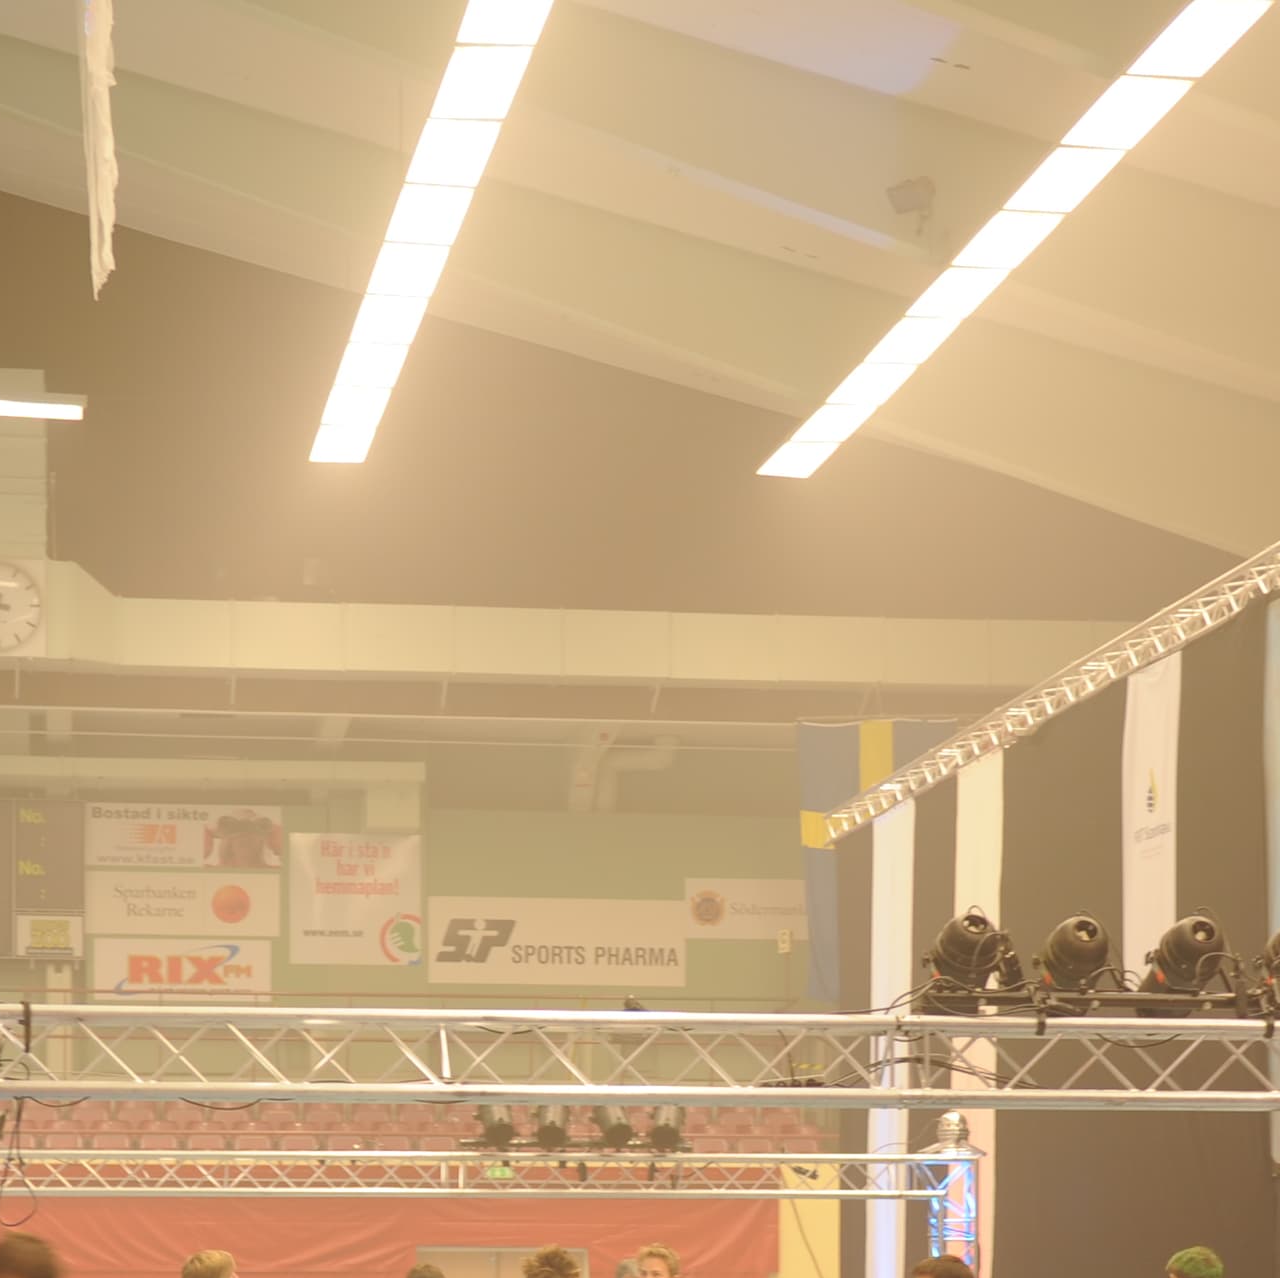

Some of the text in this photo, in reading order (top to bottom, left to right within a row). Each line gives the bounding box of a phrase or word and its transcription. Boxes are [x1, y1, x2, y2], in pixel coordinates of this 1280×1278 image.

[91, 806, 152, 819] Bostad
[167, 808, 210, 822] sikte
[18, 860, 47, 876] No.
[336, 860, 359, 877] har
[113, 884, 198, 903] Sparbanken
[512, 944, 679, 968] SPORTS PHARMA
[127, 954, 253, 986] RIX FM
